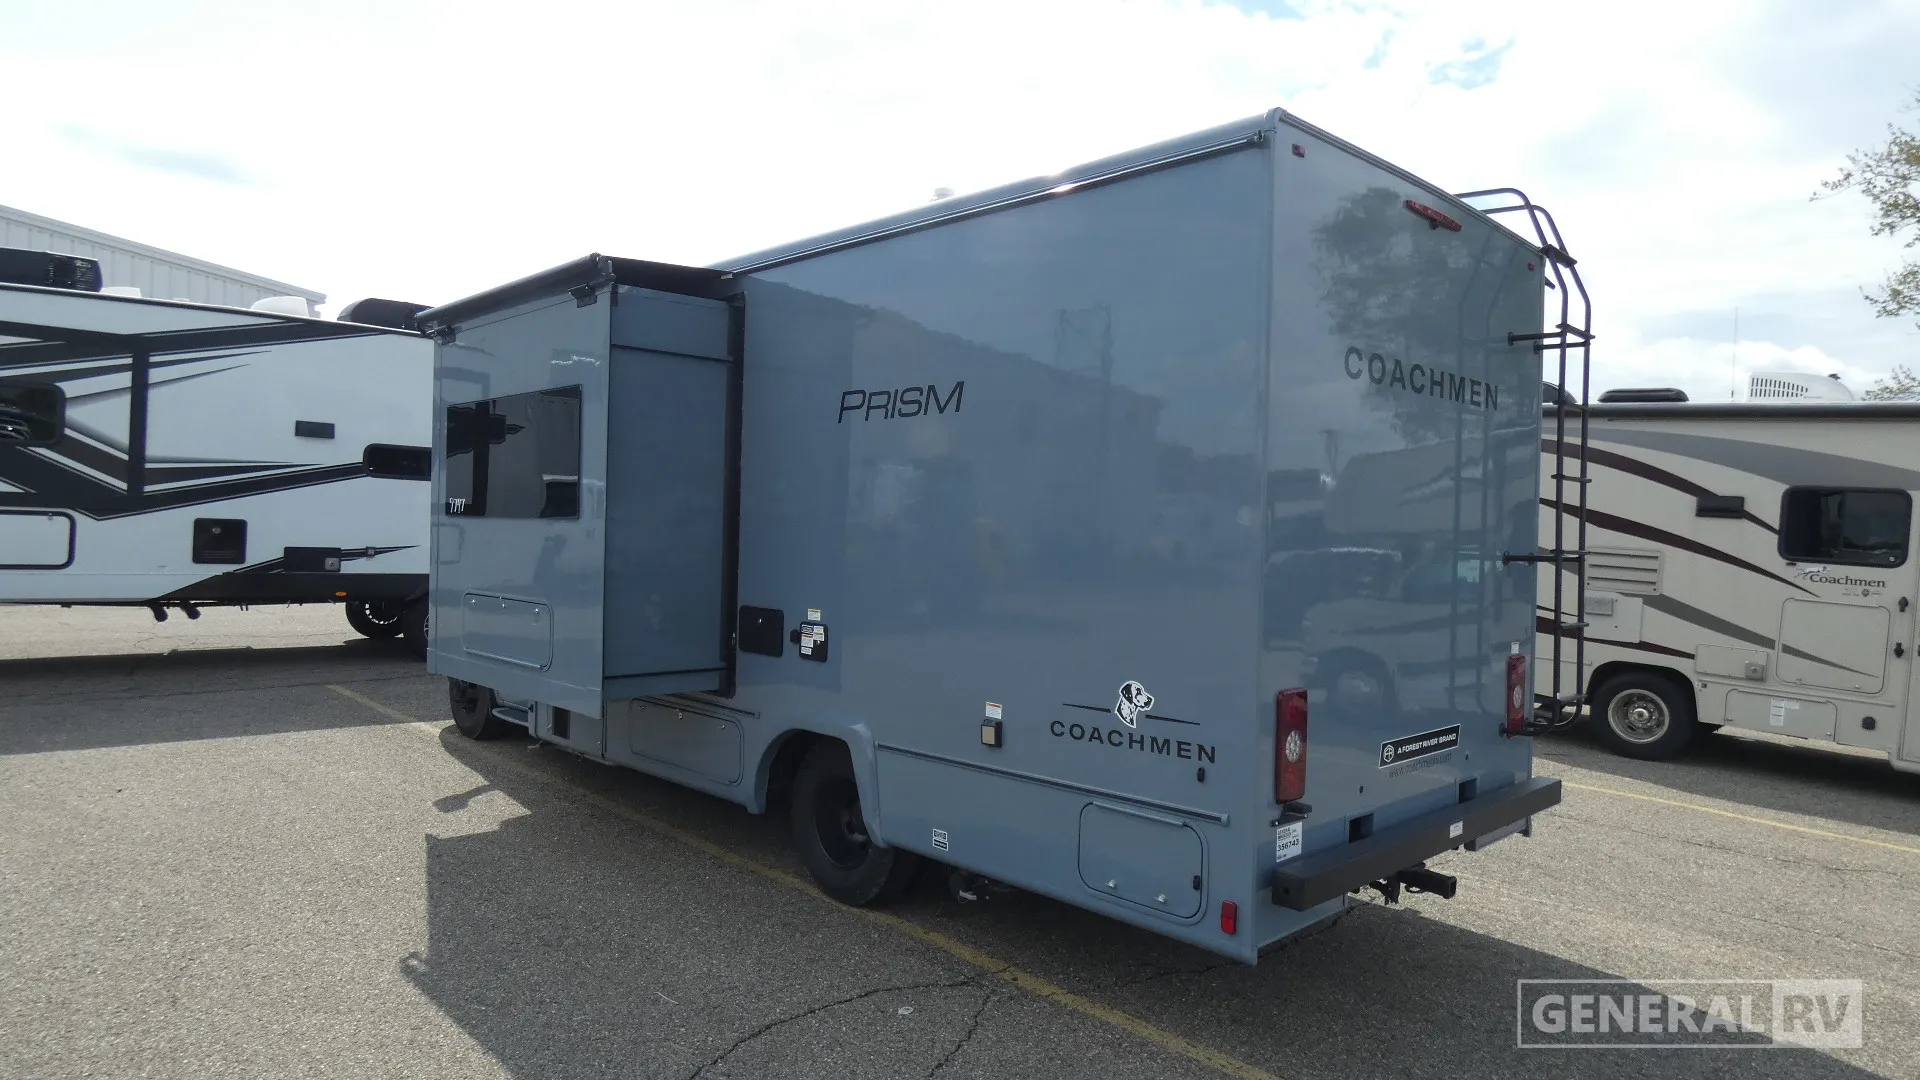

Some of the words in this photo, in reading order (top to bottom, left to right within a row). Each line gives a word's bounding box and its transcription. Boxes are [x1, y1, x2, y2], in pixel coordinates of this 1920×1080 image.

[1344, 345, 1498, 411] COACHMEN
[838, 380, 965, 424] PRISM
[1809, 573, 1886, 588] Coachmen
[1050, 720, 1216, 764] COACHMEN
[1402, 742, 1423, 753] FOREST
[1422, 737, 1438, 748] RIVER
[1438, 733, 1457, 744] BRAND
[1277, 838, 1300, 851] 356743
